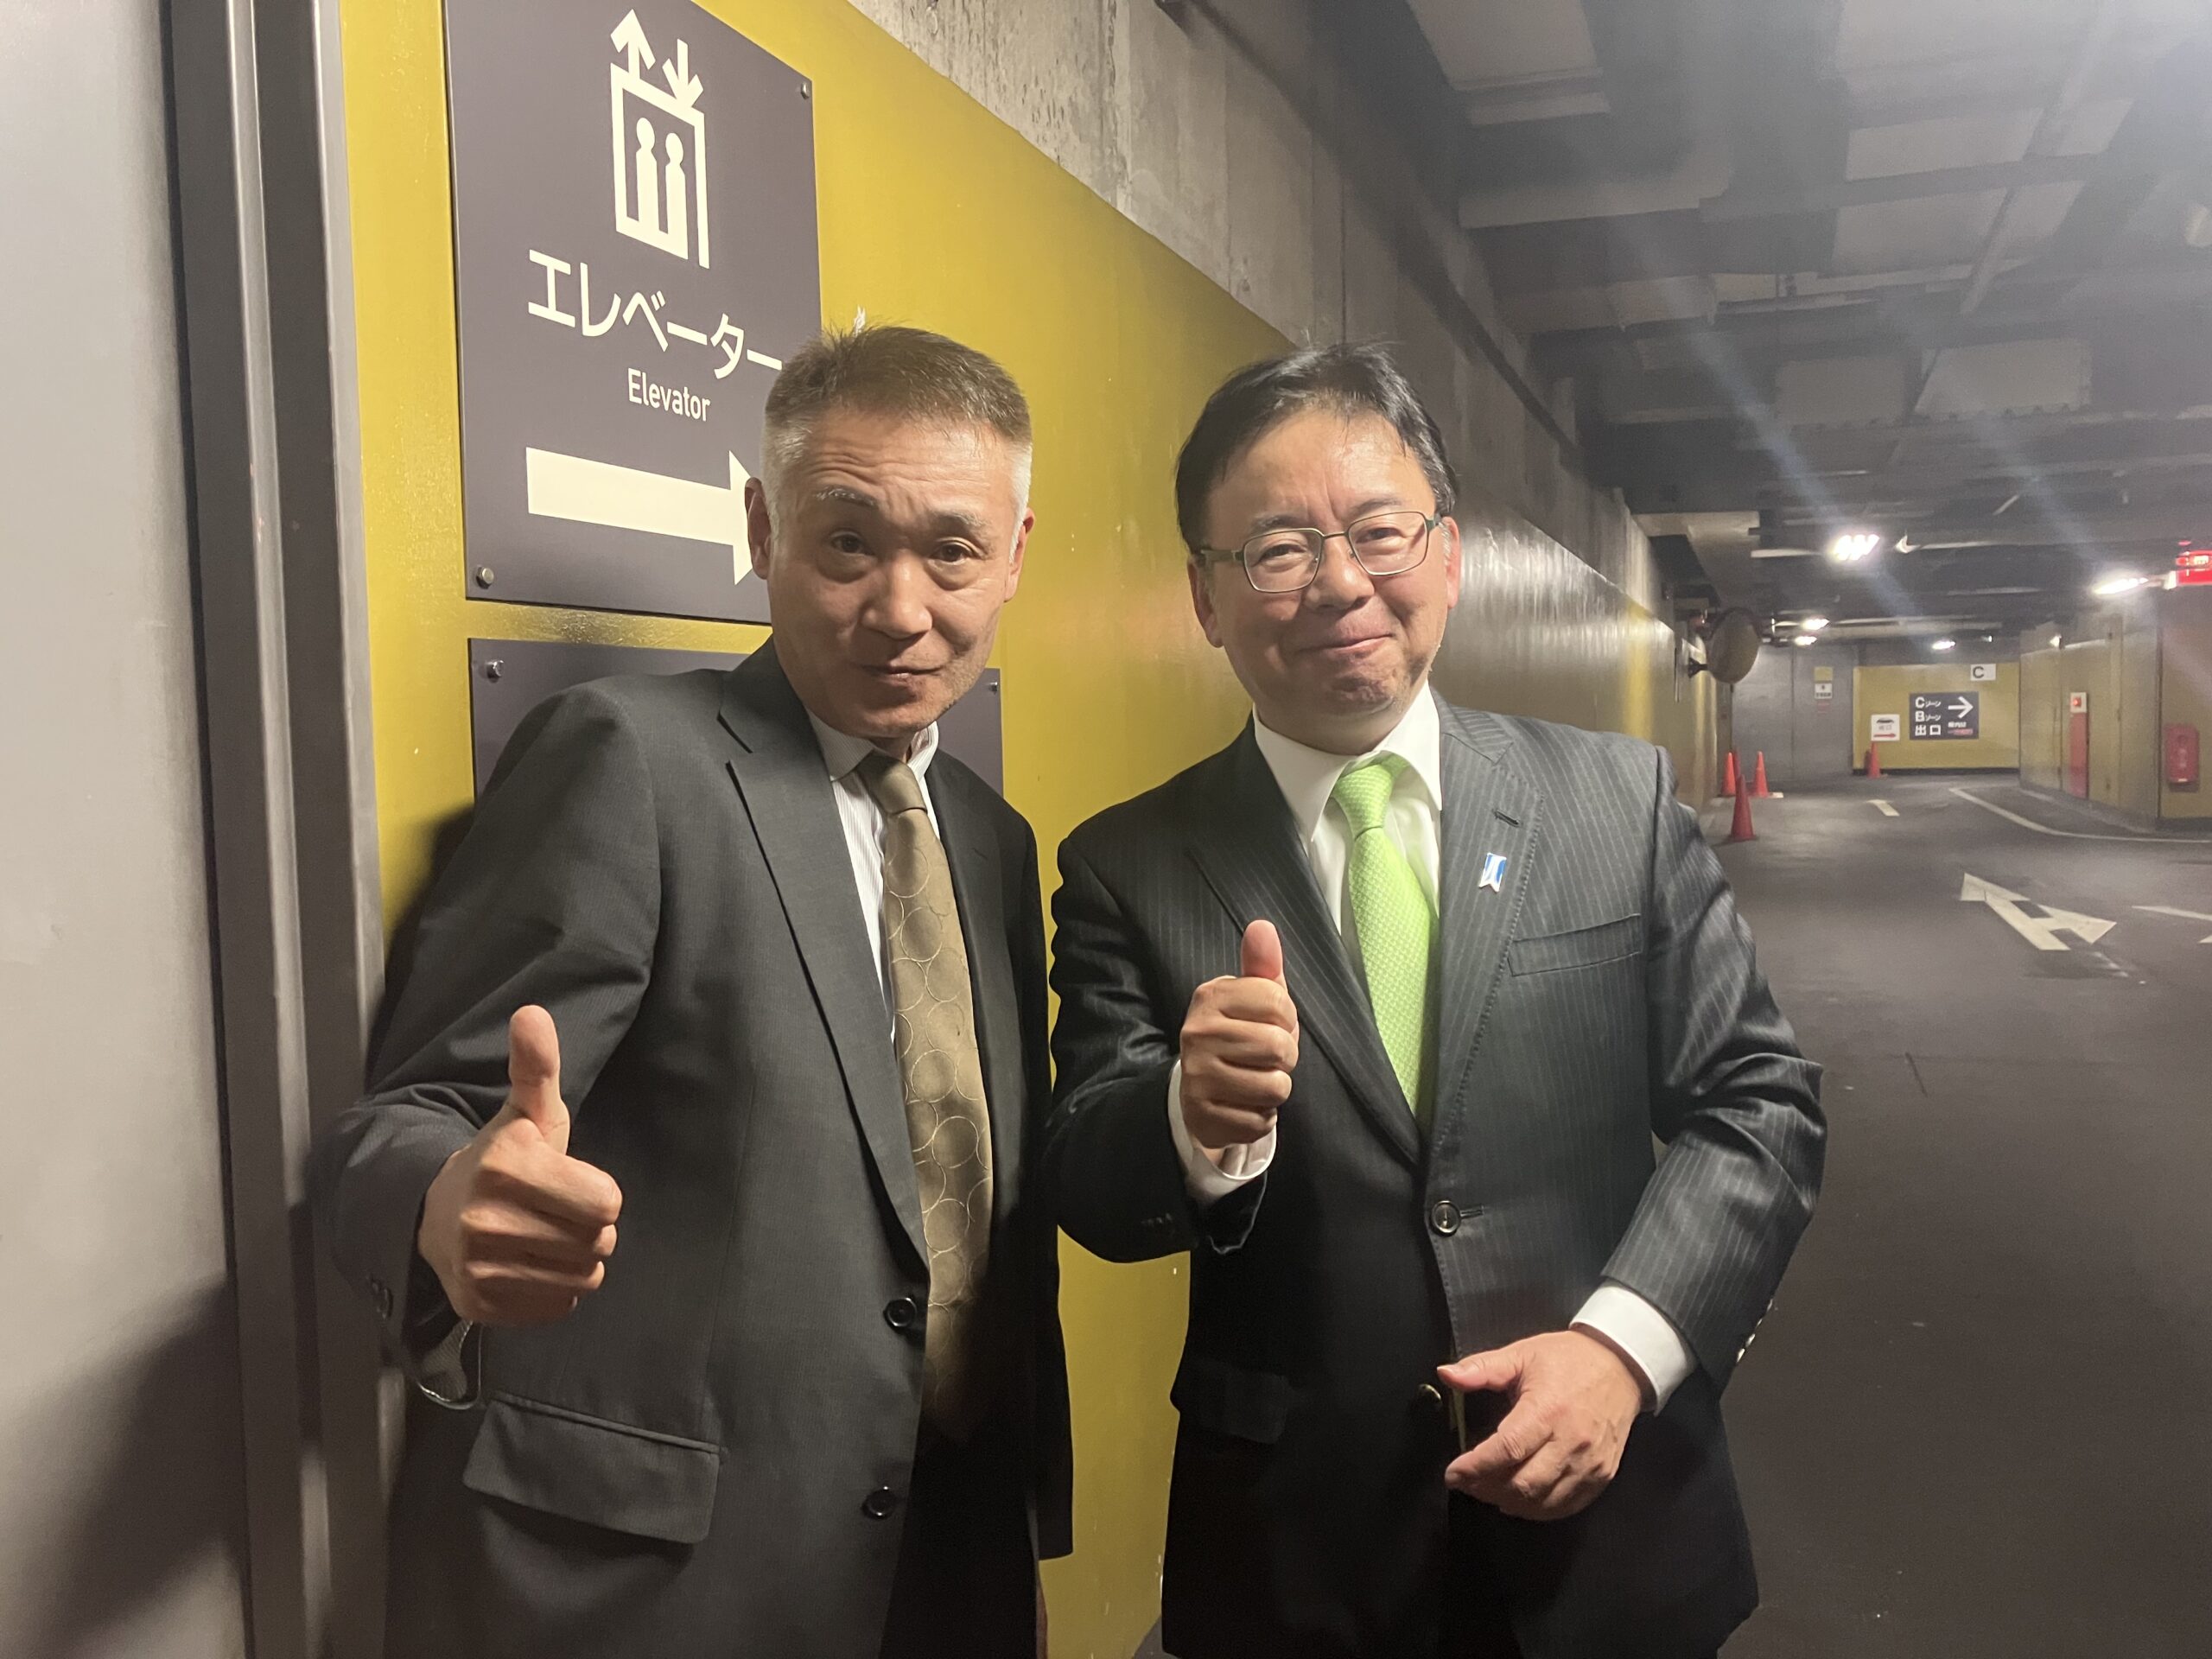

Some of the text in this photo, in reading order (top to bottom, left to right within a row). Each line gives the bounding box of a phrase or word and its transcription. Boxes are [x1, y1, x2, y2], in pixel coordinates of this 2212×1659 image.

[529, 249, 783, 379] エレベーター
[627, 367, 711, 422] Elevator
[1972, 665, 1985, 679] C
